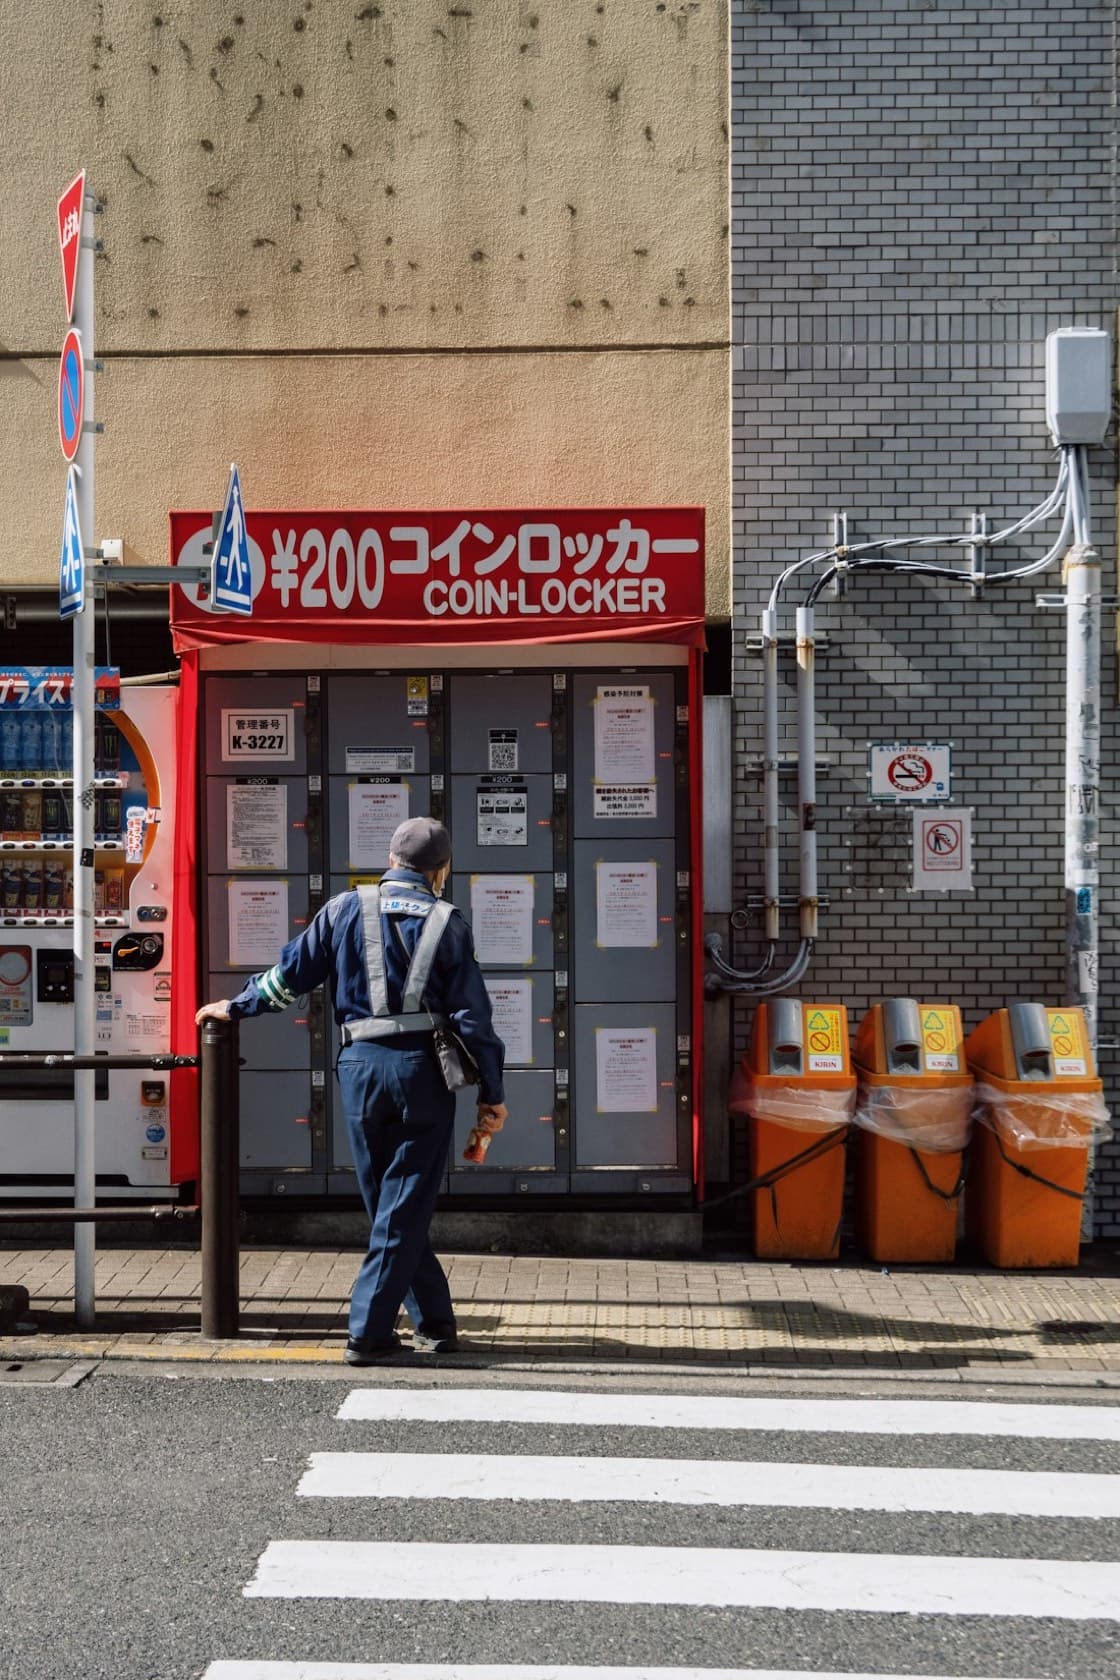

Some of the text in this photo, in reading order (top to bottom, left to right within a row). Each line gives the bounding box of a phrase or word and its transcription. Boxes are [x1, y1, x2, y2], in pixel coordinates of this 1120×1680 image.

[62, 206, 79, 249] 止まれ
[389, 518, 699, 576] コインロッカー
[270, 527, 385, 610] ¥200
[423, 577, 666, 615] COIN-LOCKER
[0, 679, 73, 705] プライス
[232, 735, 284, 750] K-3227
[235, 719, 281, 730] 管理番号
